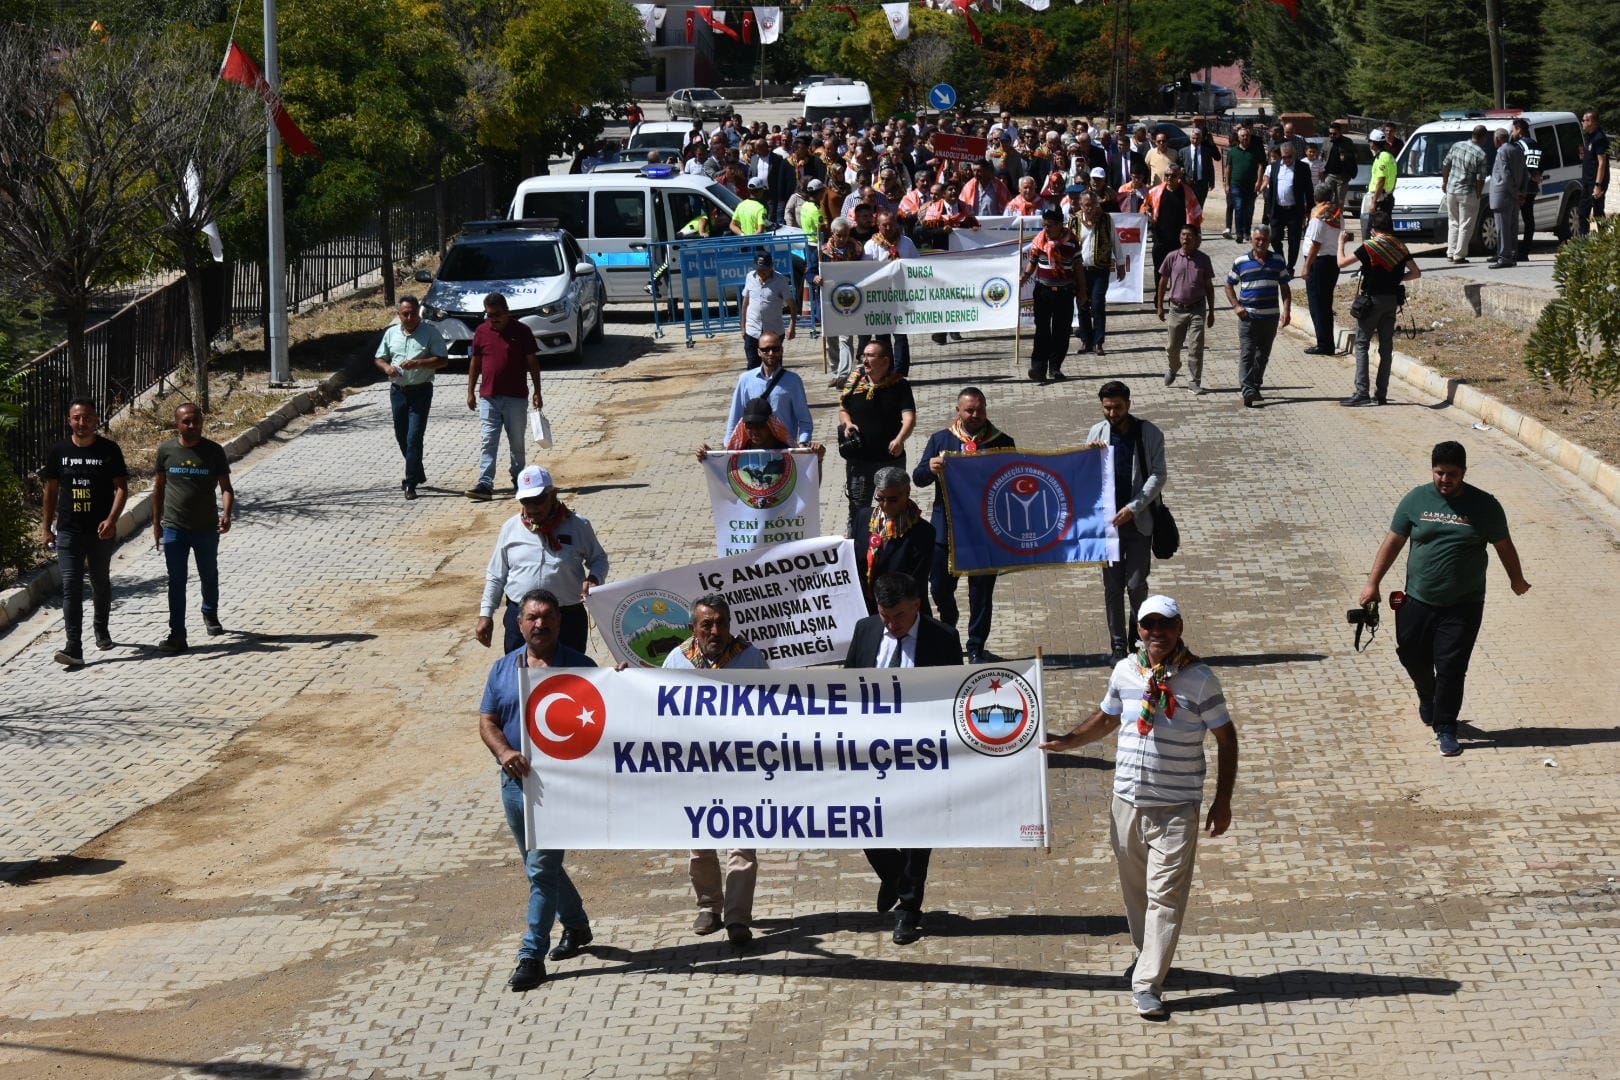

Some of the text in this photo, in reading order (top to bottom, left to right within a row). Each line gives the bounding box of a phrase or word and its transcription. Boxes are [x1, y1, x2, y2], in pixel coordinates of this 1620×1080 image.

[907, 266, 934, 279] BURSA
[866, 284, 976, 304] ERTUĞRULGAZİ KARAKEÇİLİ
[864, 306, 979, 327] YÖRÜK ve TÜRKMEN DERNEĞİ
[62, 456, 68, 466] If
[70, 458, 82, 467] you
[72, 489, 91, 499] THIS
[73, 502, 91, 512] IS IT
[729, 515, 805, 531] ÇEKİ KÖYÜ
[731, 531, 804, 544] KAYI BOYU
[698, 548, 840, 592] İÇ ANADOLU
[789, 569, 851, 593] YÖRÜKLER
[734, 594, 832, 625] DAYANIŞMA VE
[740, 615, 838, 643] YARDIMLAŞMA
[657, 675, 902, 717] KIRIKKALE İLİ
[613, 729, 949, 781] KARAKEÇİLİ İLÇESİ
[684, 796, 884, 839] YÖRÜKLERİ
